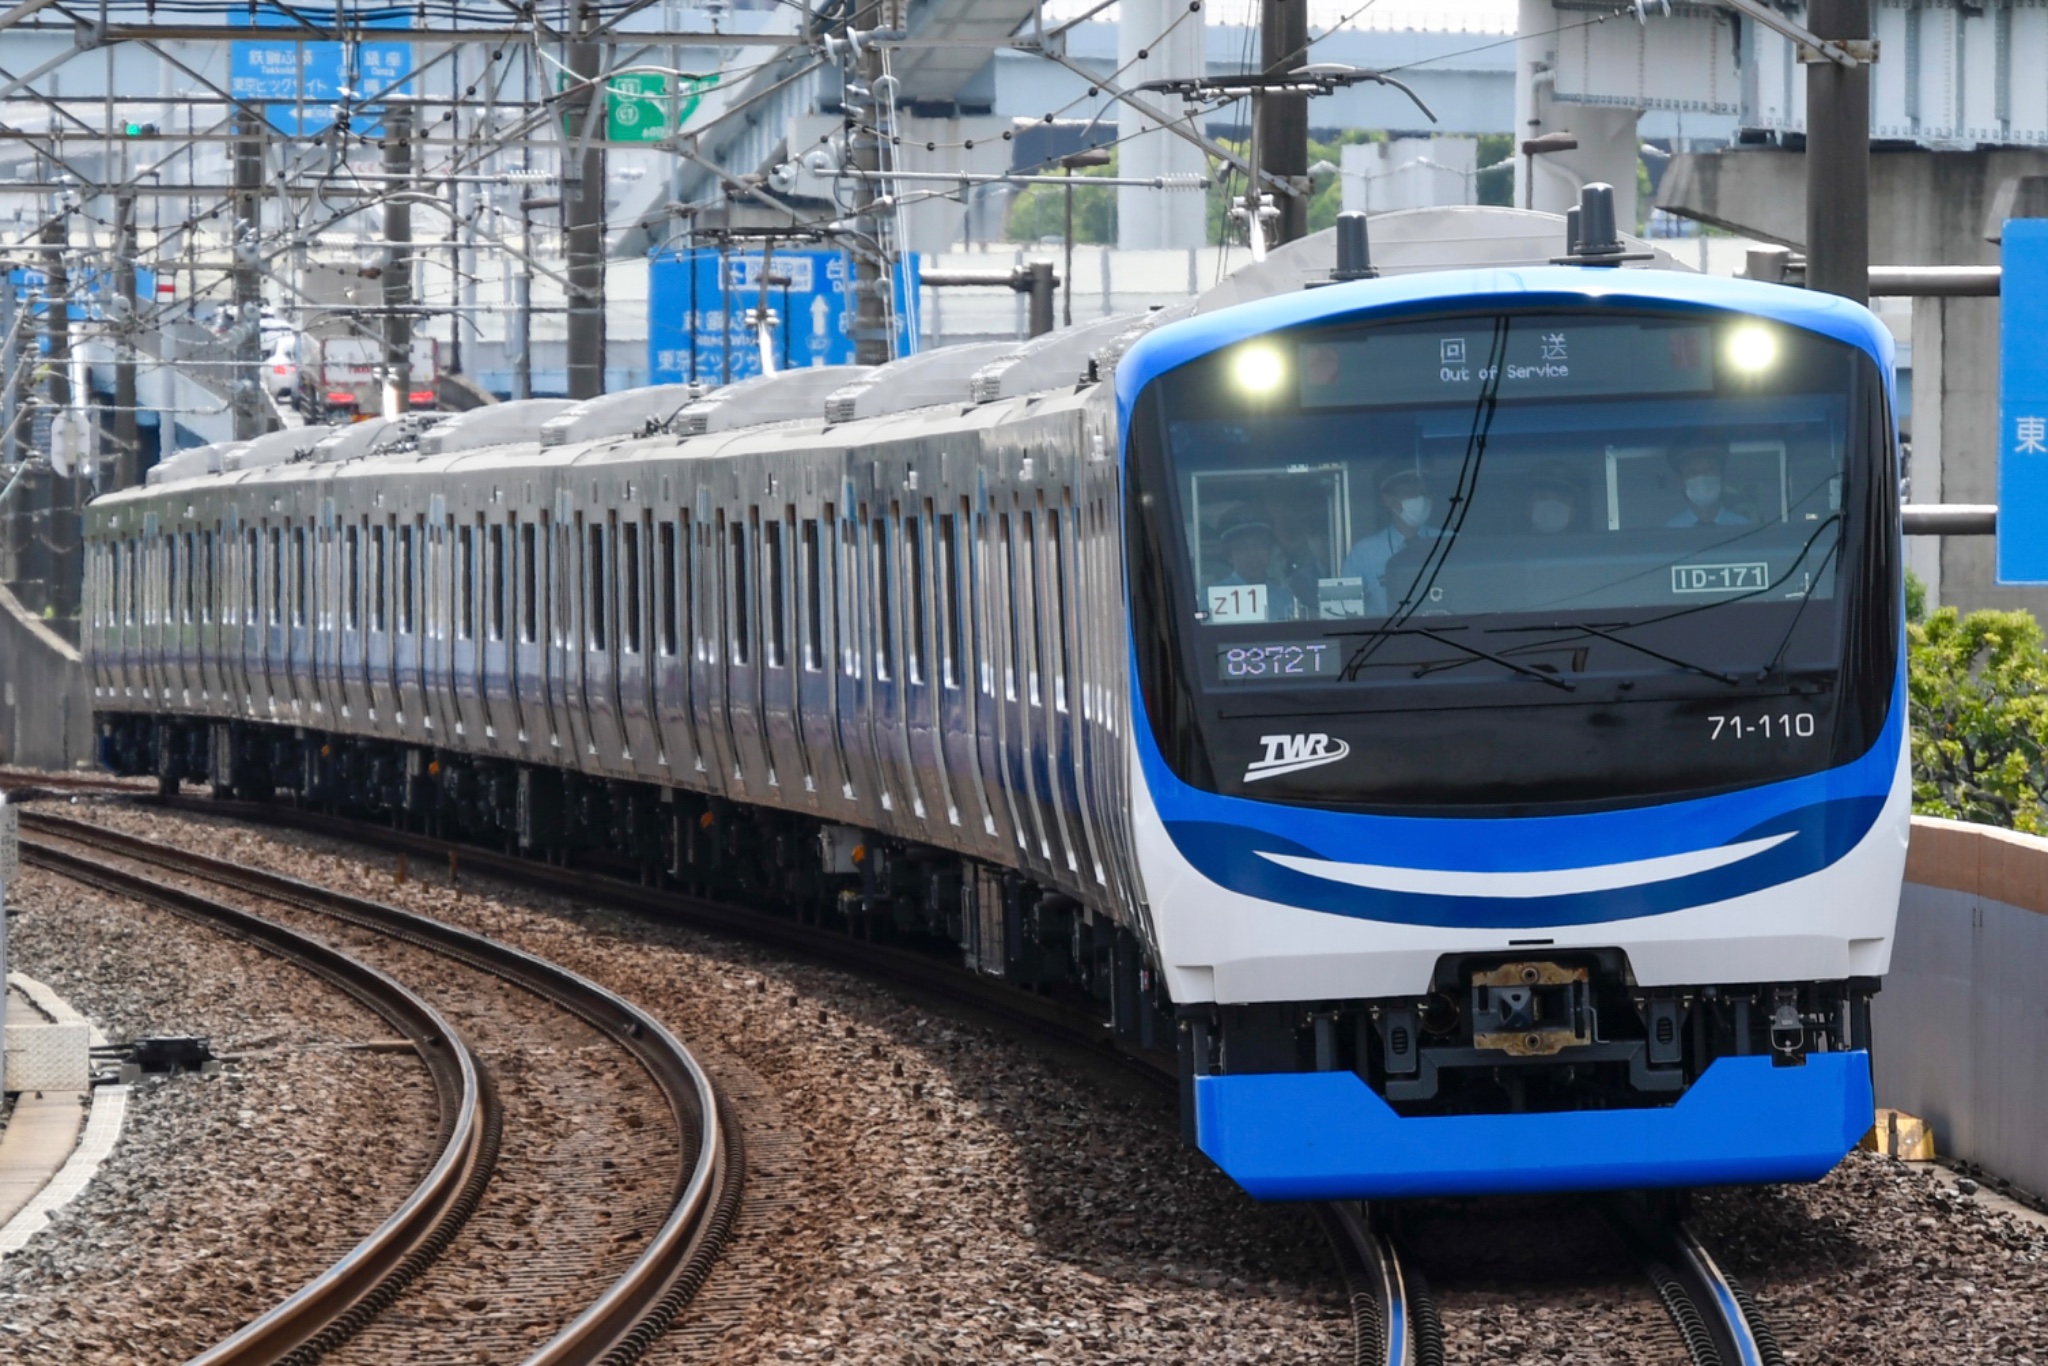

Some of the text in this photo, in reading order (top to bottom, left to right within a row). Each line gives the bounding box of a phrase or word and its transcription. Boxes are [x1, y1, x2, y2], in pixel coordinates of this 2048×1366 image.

[1441, 333, 1568, 363] 回送
[1440, 363, 1569, 382] Out of Service
[2014, 416, 2047, 454] 東
[1681, 567, 1762, 588] ID-171
[1227, 645, 1327, 676] 8372T
[1707, 712, 1815, 740] 71-110
[1259, 732, 1330, 763] TWR
